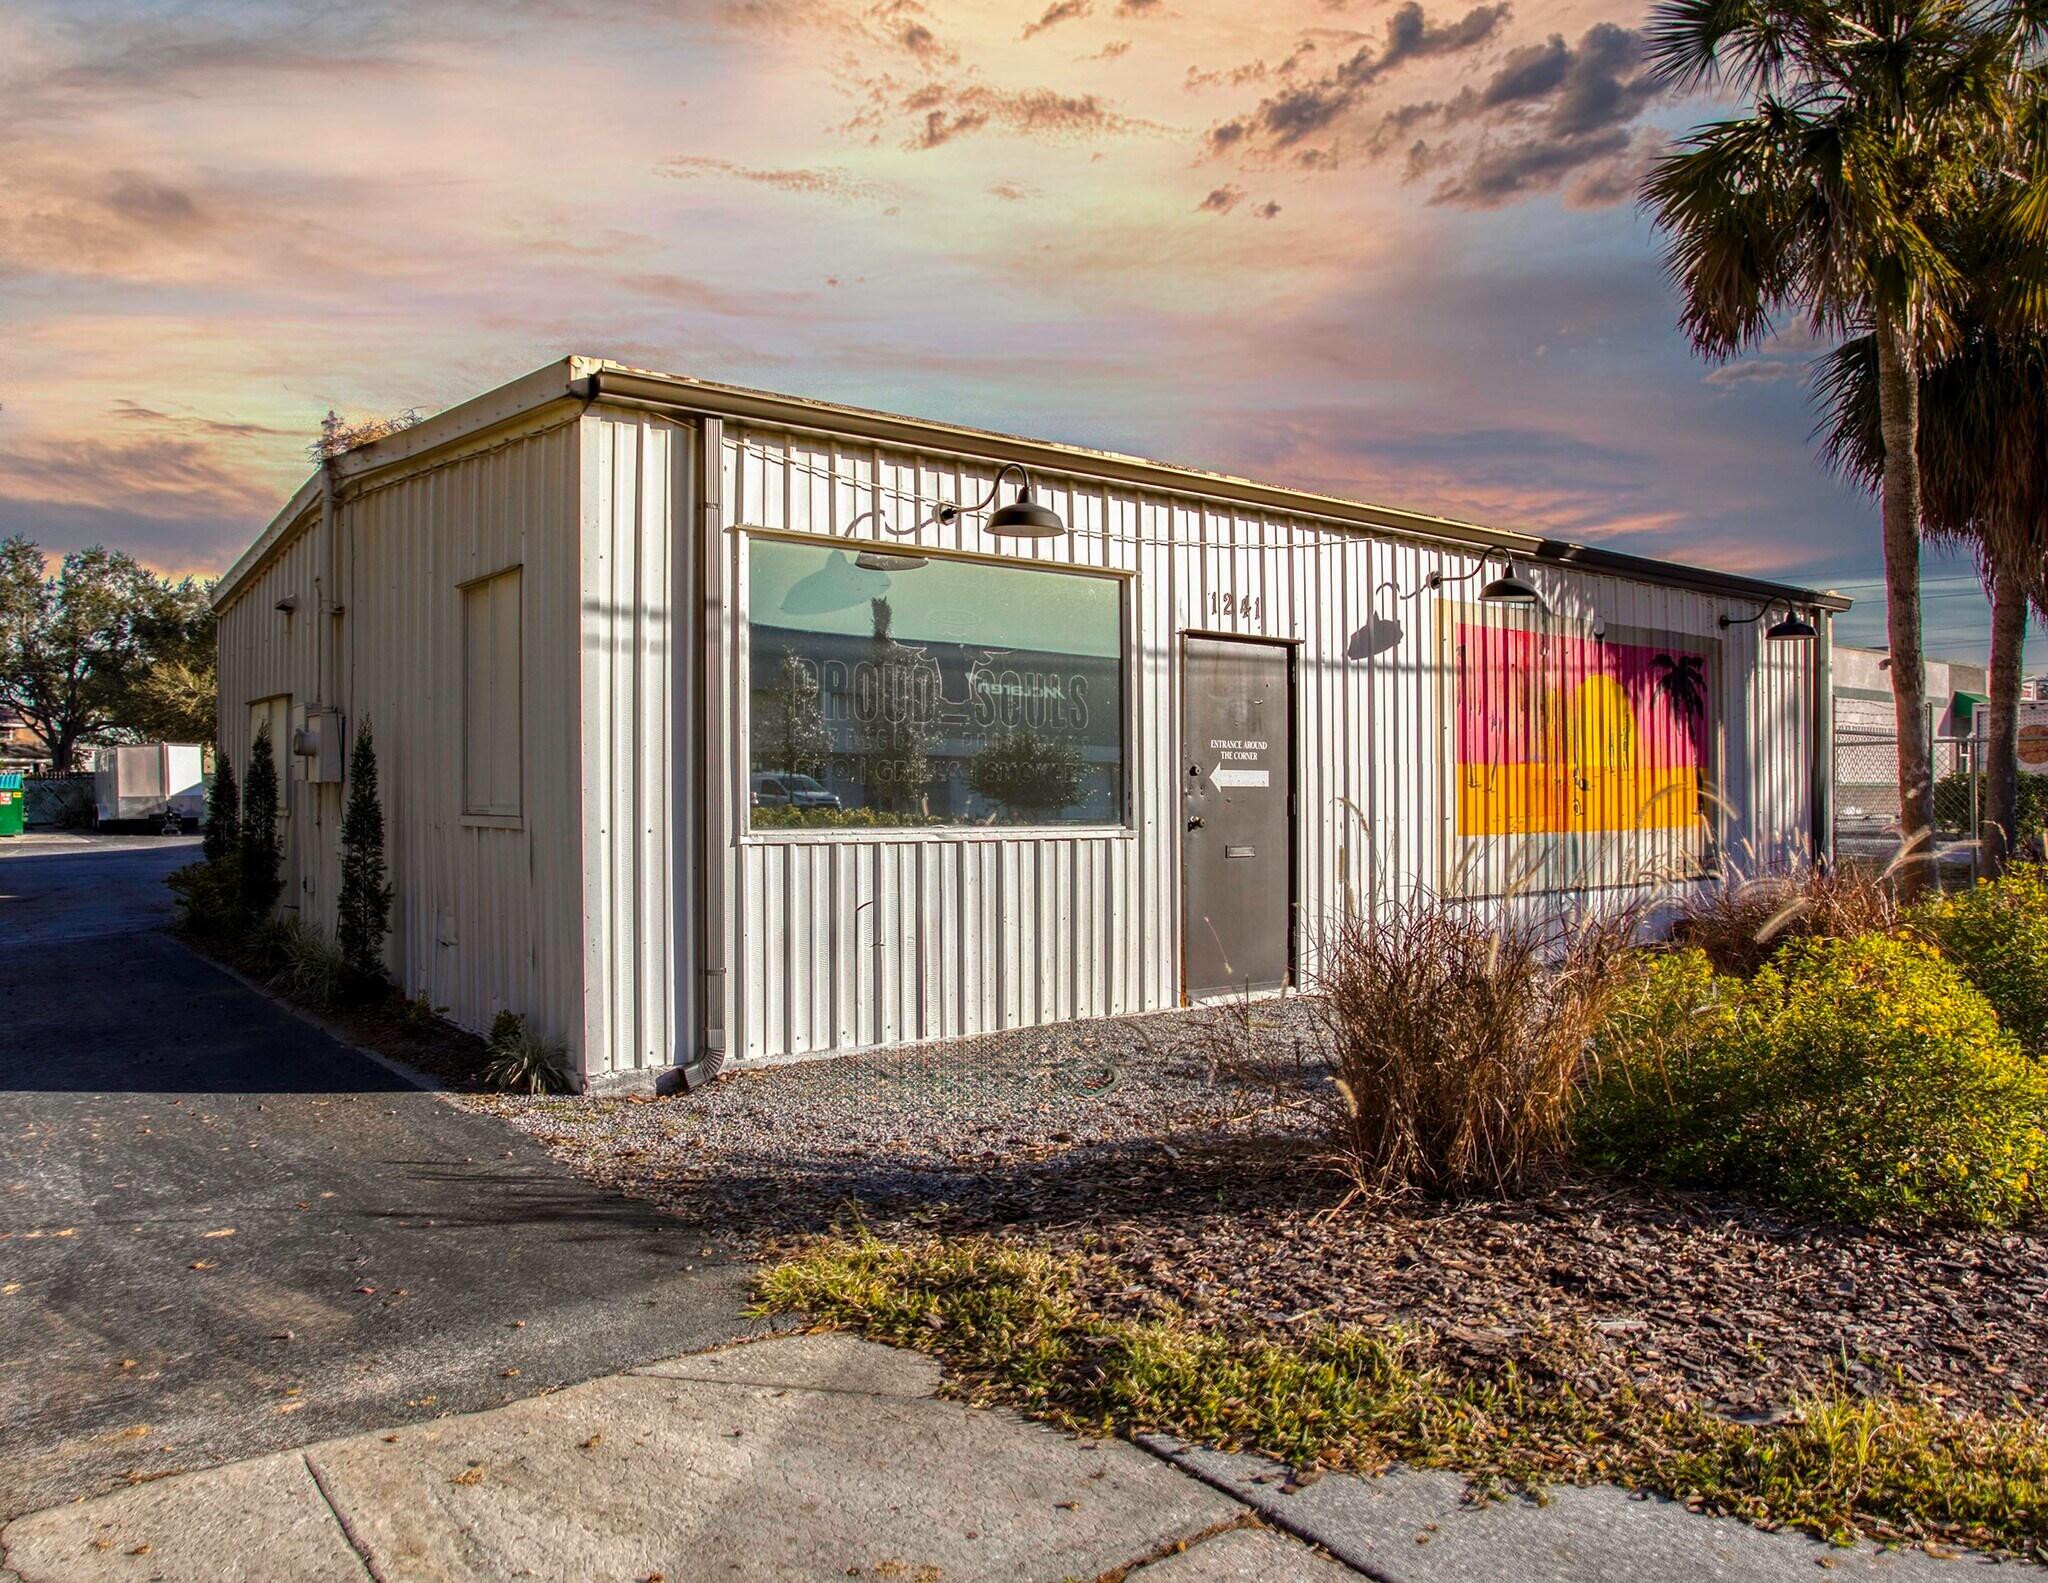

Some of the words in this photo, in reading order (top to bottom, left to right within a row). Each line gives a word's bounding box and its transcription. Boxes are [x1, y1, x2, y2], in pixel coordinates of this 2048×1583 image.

[1211, 591, 1260, 620] 1241
[793, 658, 936, 724] PROUD
[974, 668, 1089, 730] SOULS
[1210, 739, 1242, 749] ENTRANCE
[1243, 740, 1268, 750] AROUND
[1220, 751, 1233, 760] THE
[1233, 751, 1258, 760] CORNER
